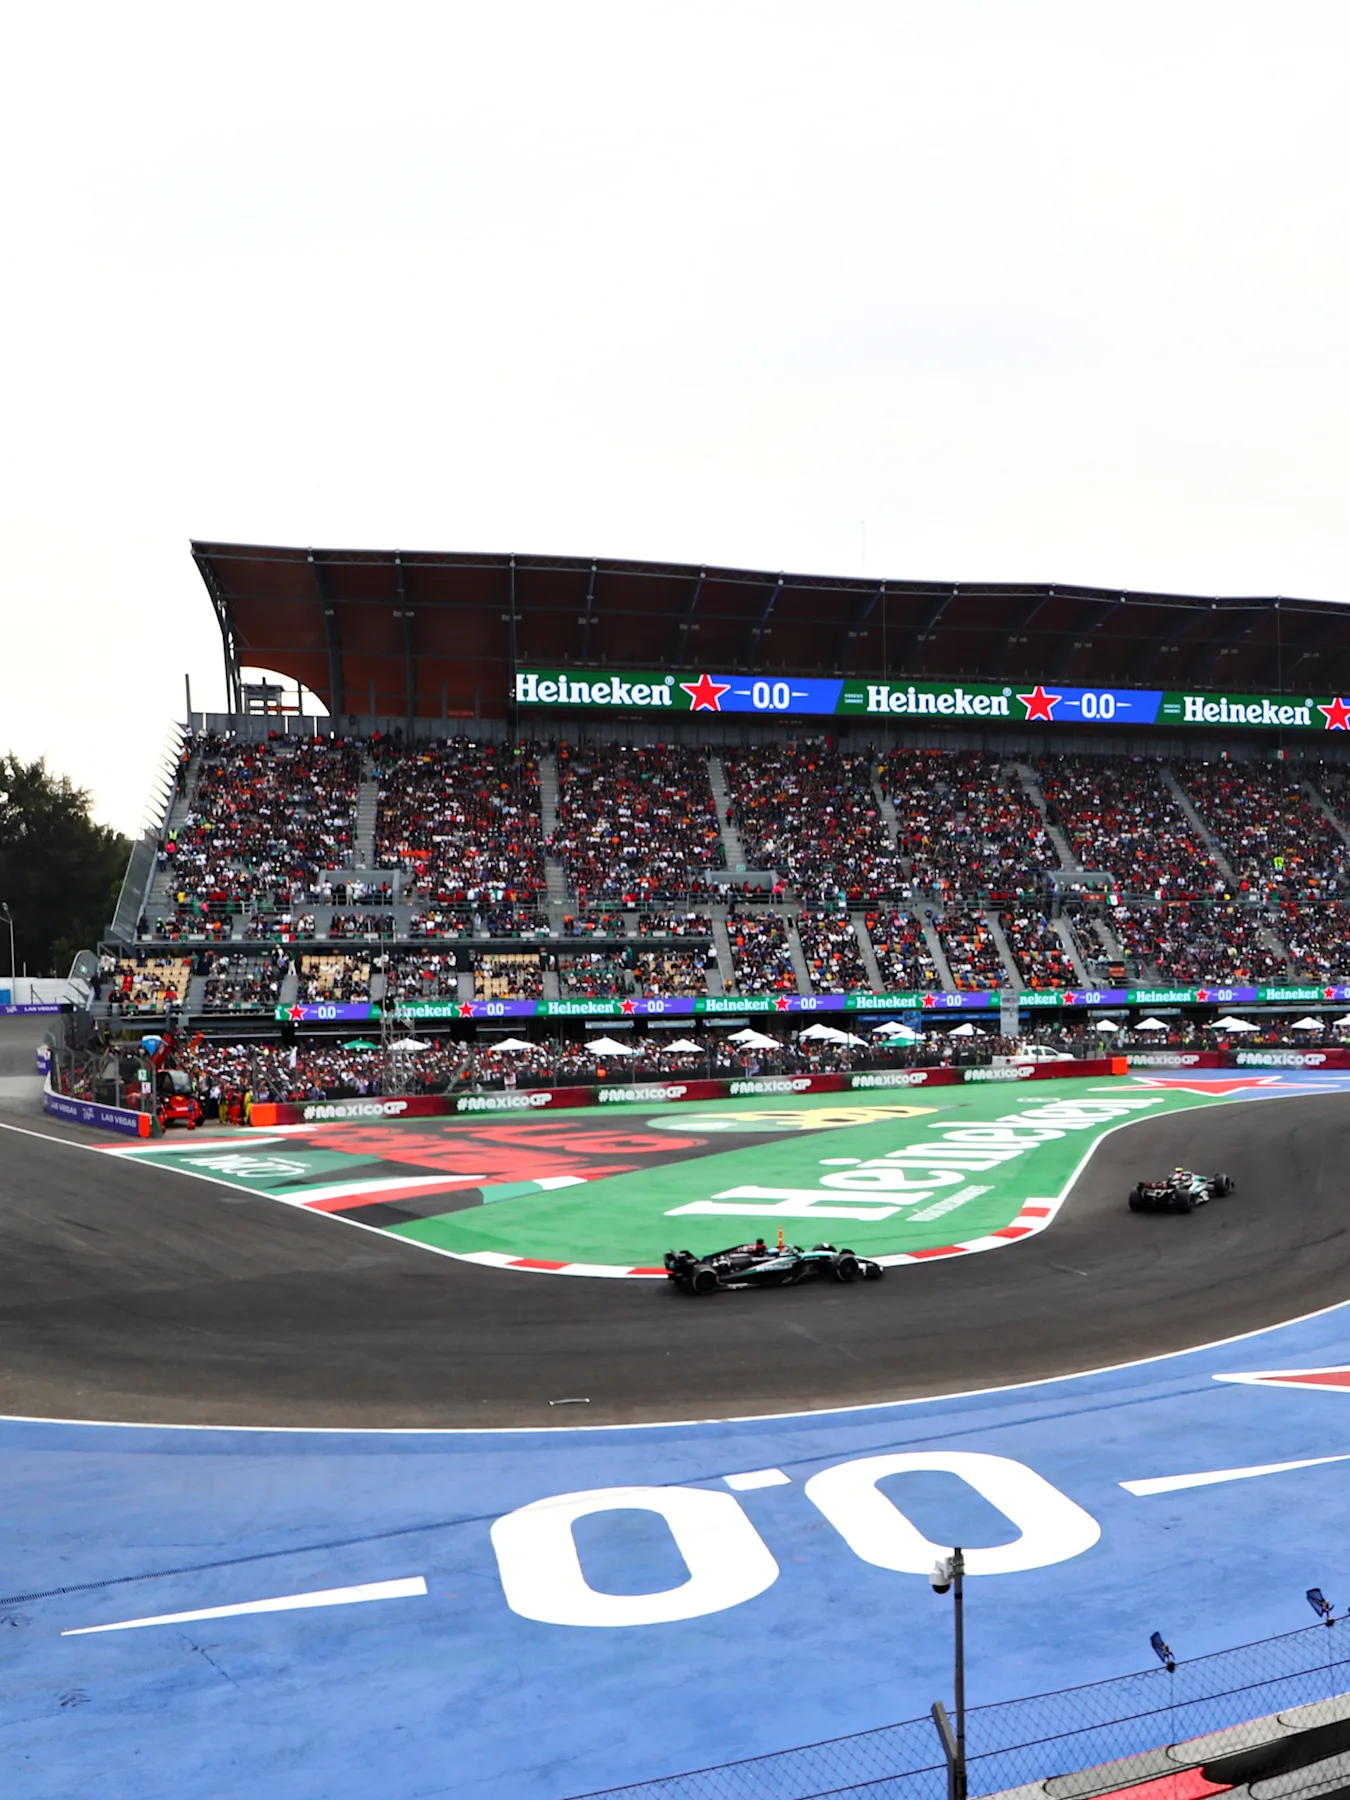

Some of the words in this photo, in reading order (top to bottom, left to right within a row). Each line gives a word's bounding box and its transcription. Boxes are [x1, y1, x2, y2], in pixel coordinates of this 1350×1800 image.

[1236, 1054, 1326, 1065] #MexicoGP
[852, 1073, 927, 1087] #MexicoGP
[964, 1067, 1034, 1080] #MexicoGP
[599, 1086, 687, 1102] #MexicoGP
[730, 1078, 811, 1094] #MexicoGP
[457, 1093, 552, 1111] #MexicoGP
[304, 1101, 407, 1120] #MexicoGP
[101, 1112, 113, 1122] LAS
[114, 1115, 137, 1128] VEGAS
